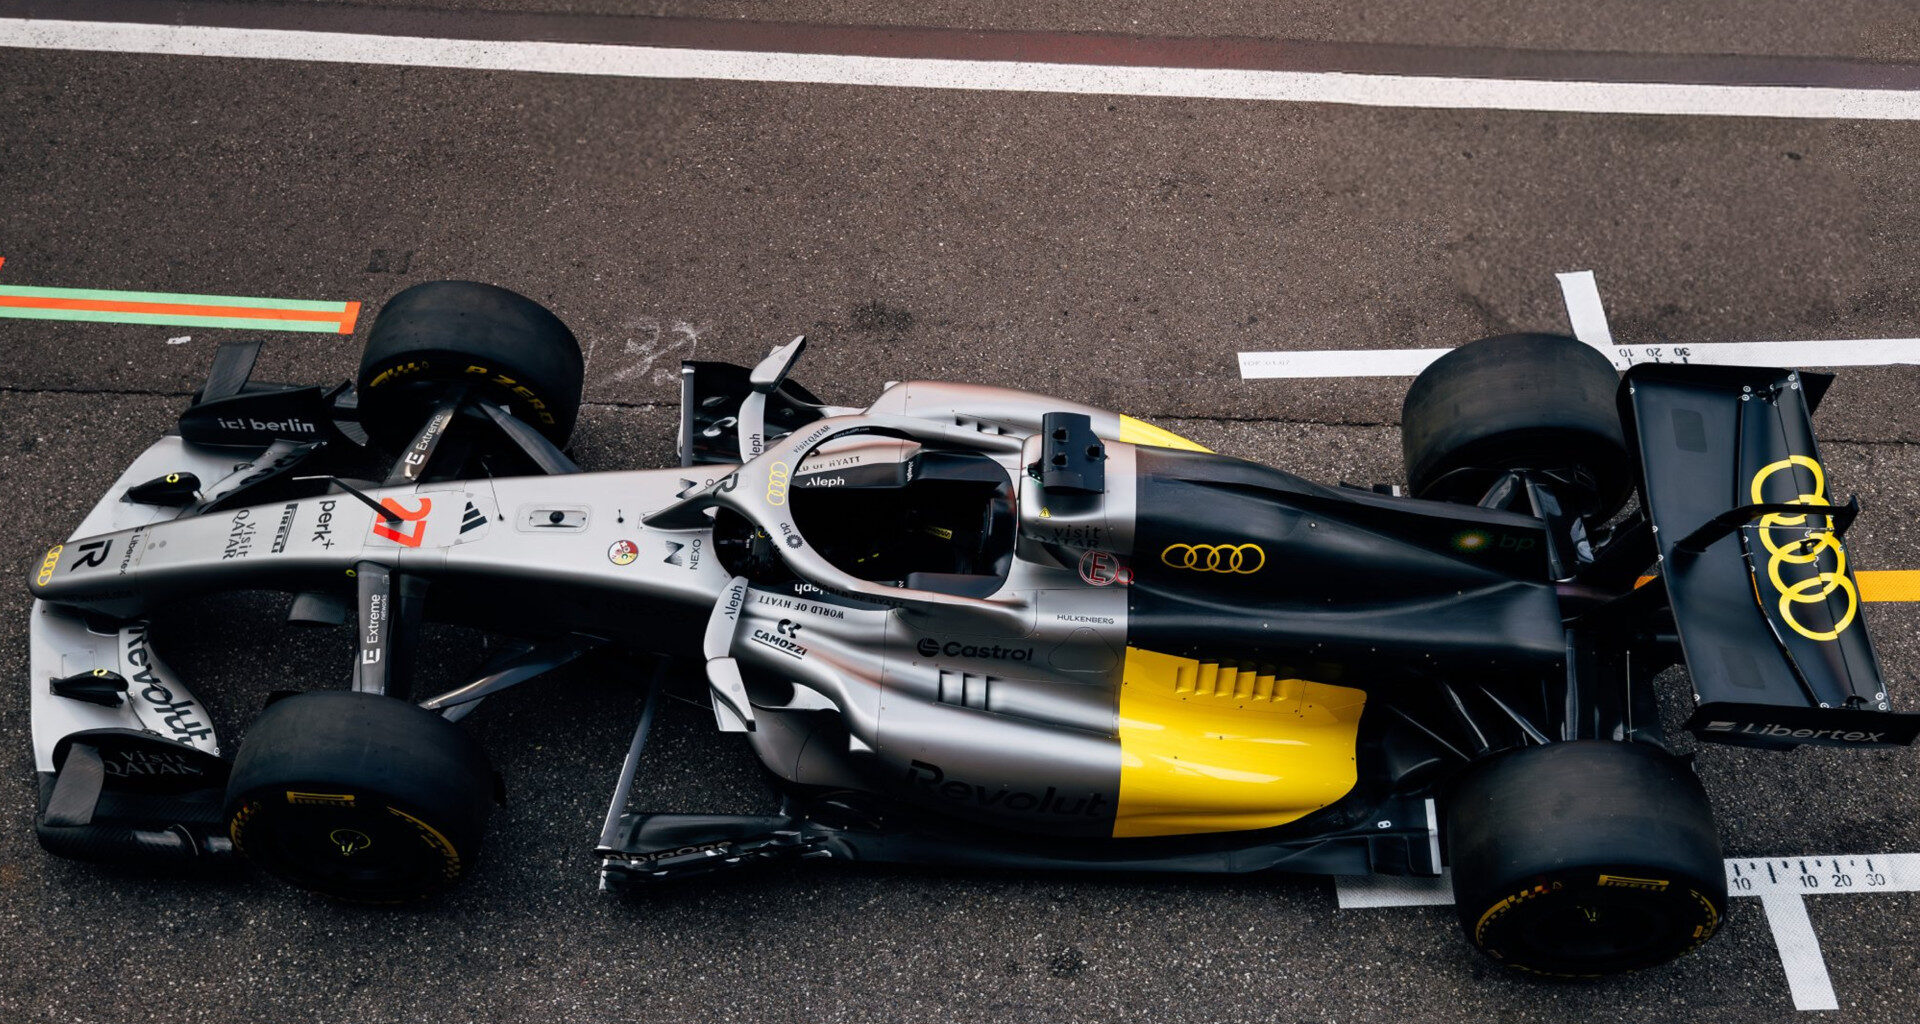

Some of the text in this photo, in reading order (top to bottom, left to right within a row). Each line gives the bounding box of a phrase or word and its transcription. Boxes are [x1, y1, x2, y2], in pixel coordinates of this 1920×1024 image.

[1618, 347, 1691, 358] 30 20 10
[250, 418, 315, 433] berlin
[416, 414, 443, 451] Extreme
[749, 433, 761, 457] leph
[806, 476, 845, 488] Aleph
[223, 509, 250, 560] QATAR
[270, 503, 299, 554] PIRELLI
[373, 497, 431, 547] 27
[1053, 524, 1101, 538] visit
[237, 521, 257, 558] visit
[1499, 533, 1536, 552] bp
[119, 534, 141, 576] Libertex
[689, 539, 702, 570] NEXO
[724, 584, 743, 620] Aleph
[759, 595, 844, 619] WORLD OF HYATT
[367, 593, 382, 645] Extreme
[1056, 614, 1115, 625] HULKENBERG
[754, 629, 808, 656] CAMOZZI
[942, 641, 1034, 661] Castrol
[1741, 723, 1886, 743] Libertex
[905, 758, 1110, 817] Revolut
[1731, 873, 1886, 890] 10 10 20 30
